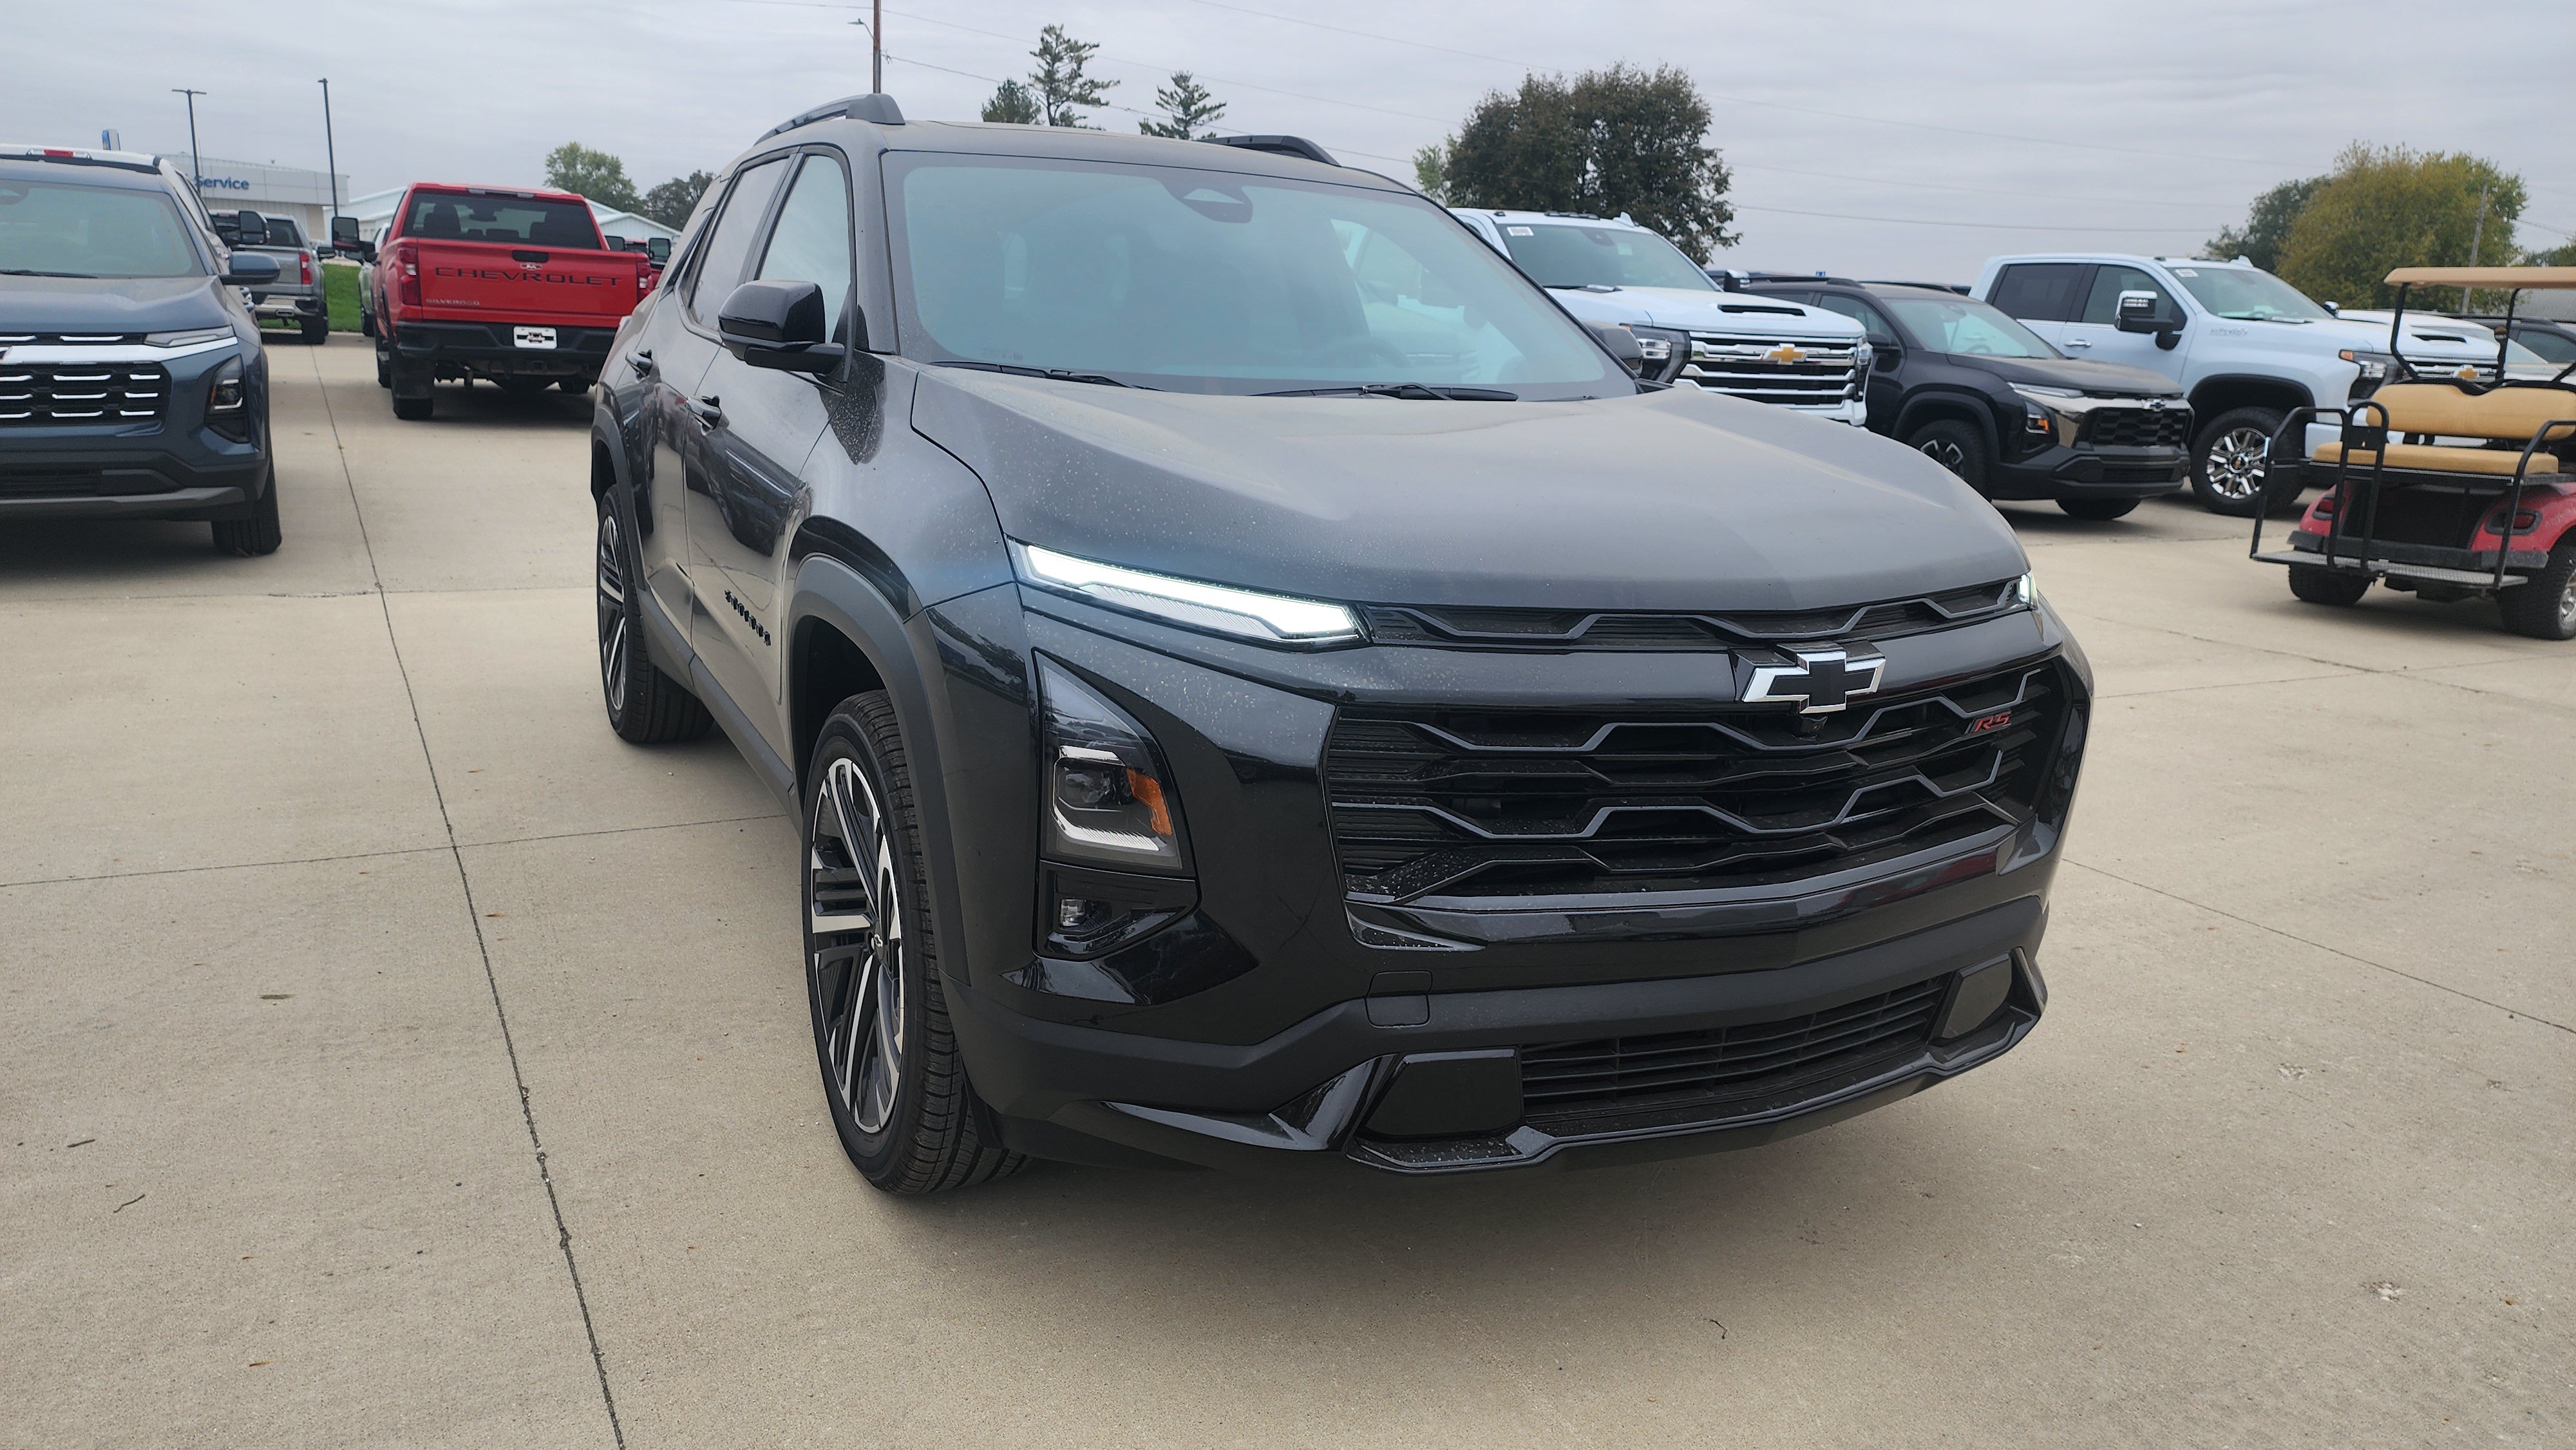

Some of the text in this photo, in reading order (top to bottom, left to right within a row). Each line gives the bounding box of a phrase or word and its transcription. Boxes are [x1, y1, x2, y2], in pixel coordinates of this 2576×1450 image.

[194, 174, 249, 190] Service
[435, 267, 622, 287] CHEVROLET
[1974, 710, 2012, 732] RS
